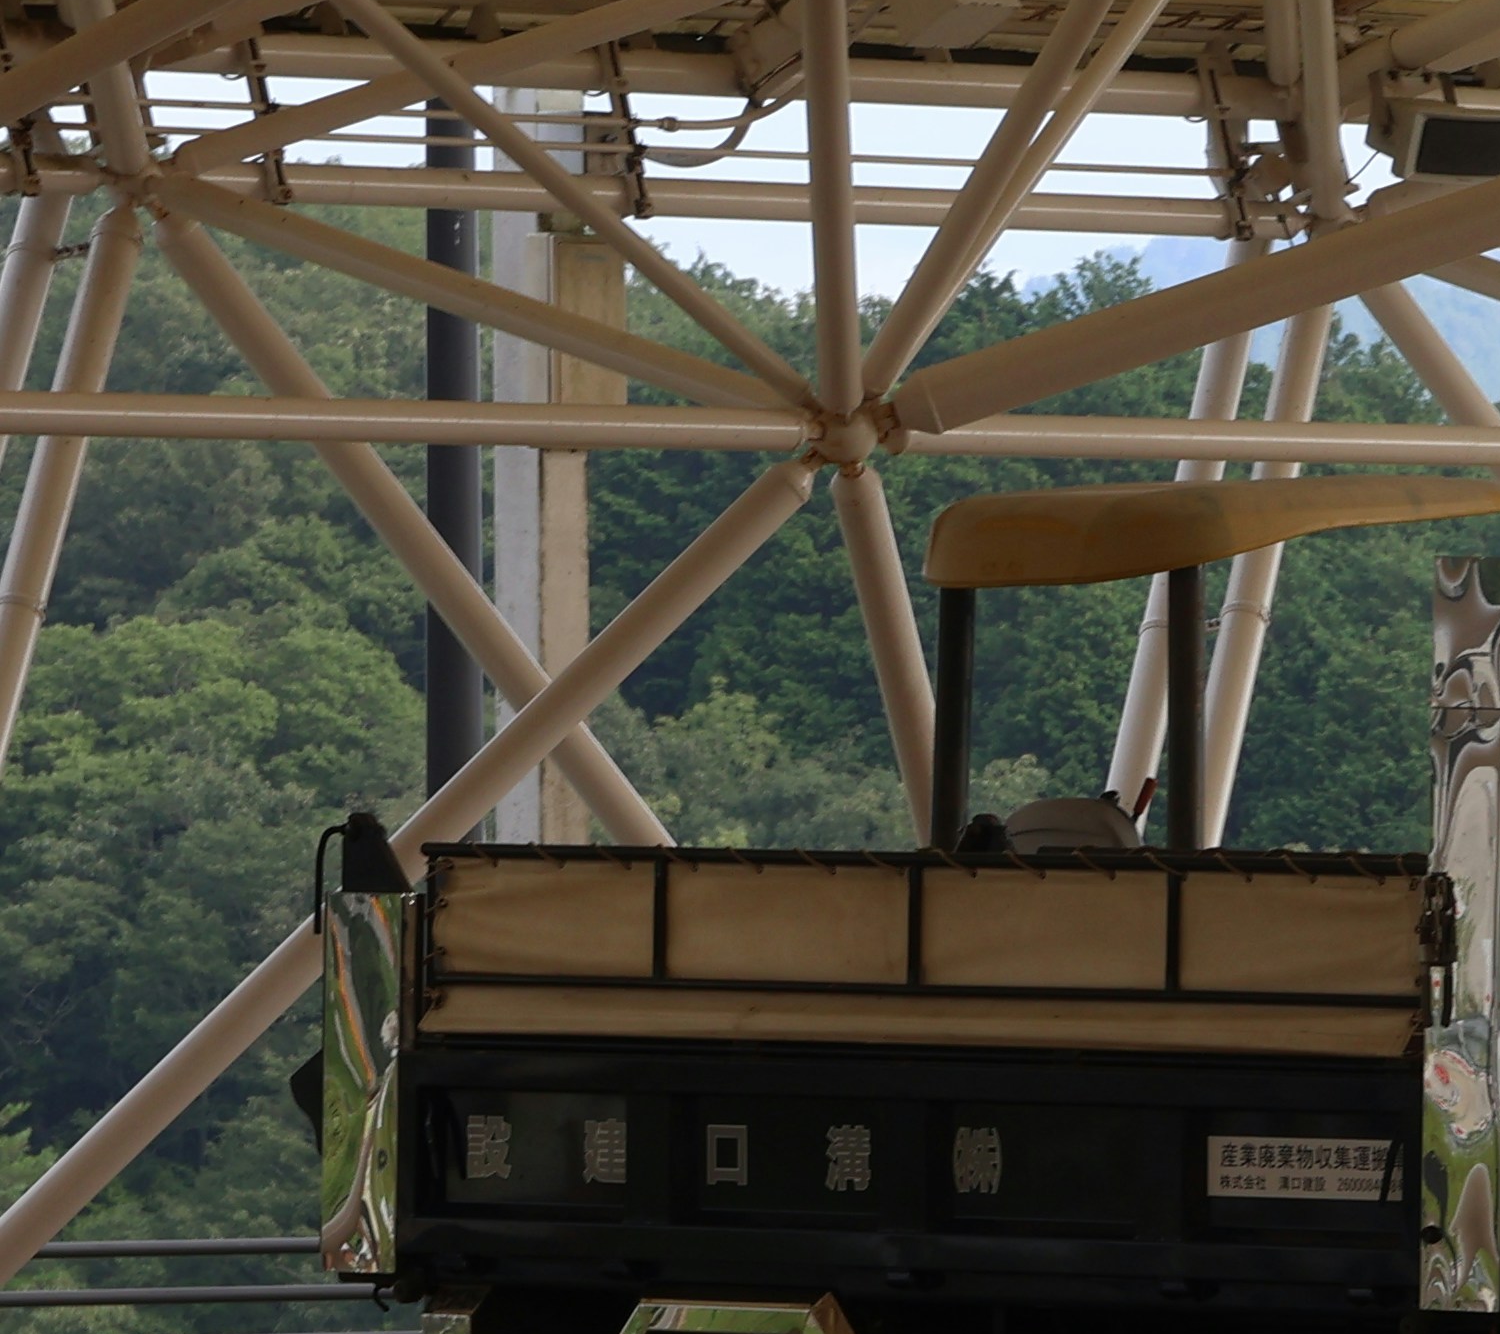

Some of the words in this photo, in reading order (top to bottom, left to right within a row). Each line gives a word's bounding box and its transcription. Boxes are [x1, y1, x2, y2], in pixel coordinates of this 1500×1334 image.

[1220, 1142, 1403, 1172] 産業廃棄物収集運搬
